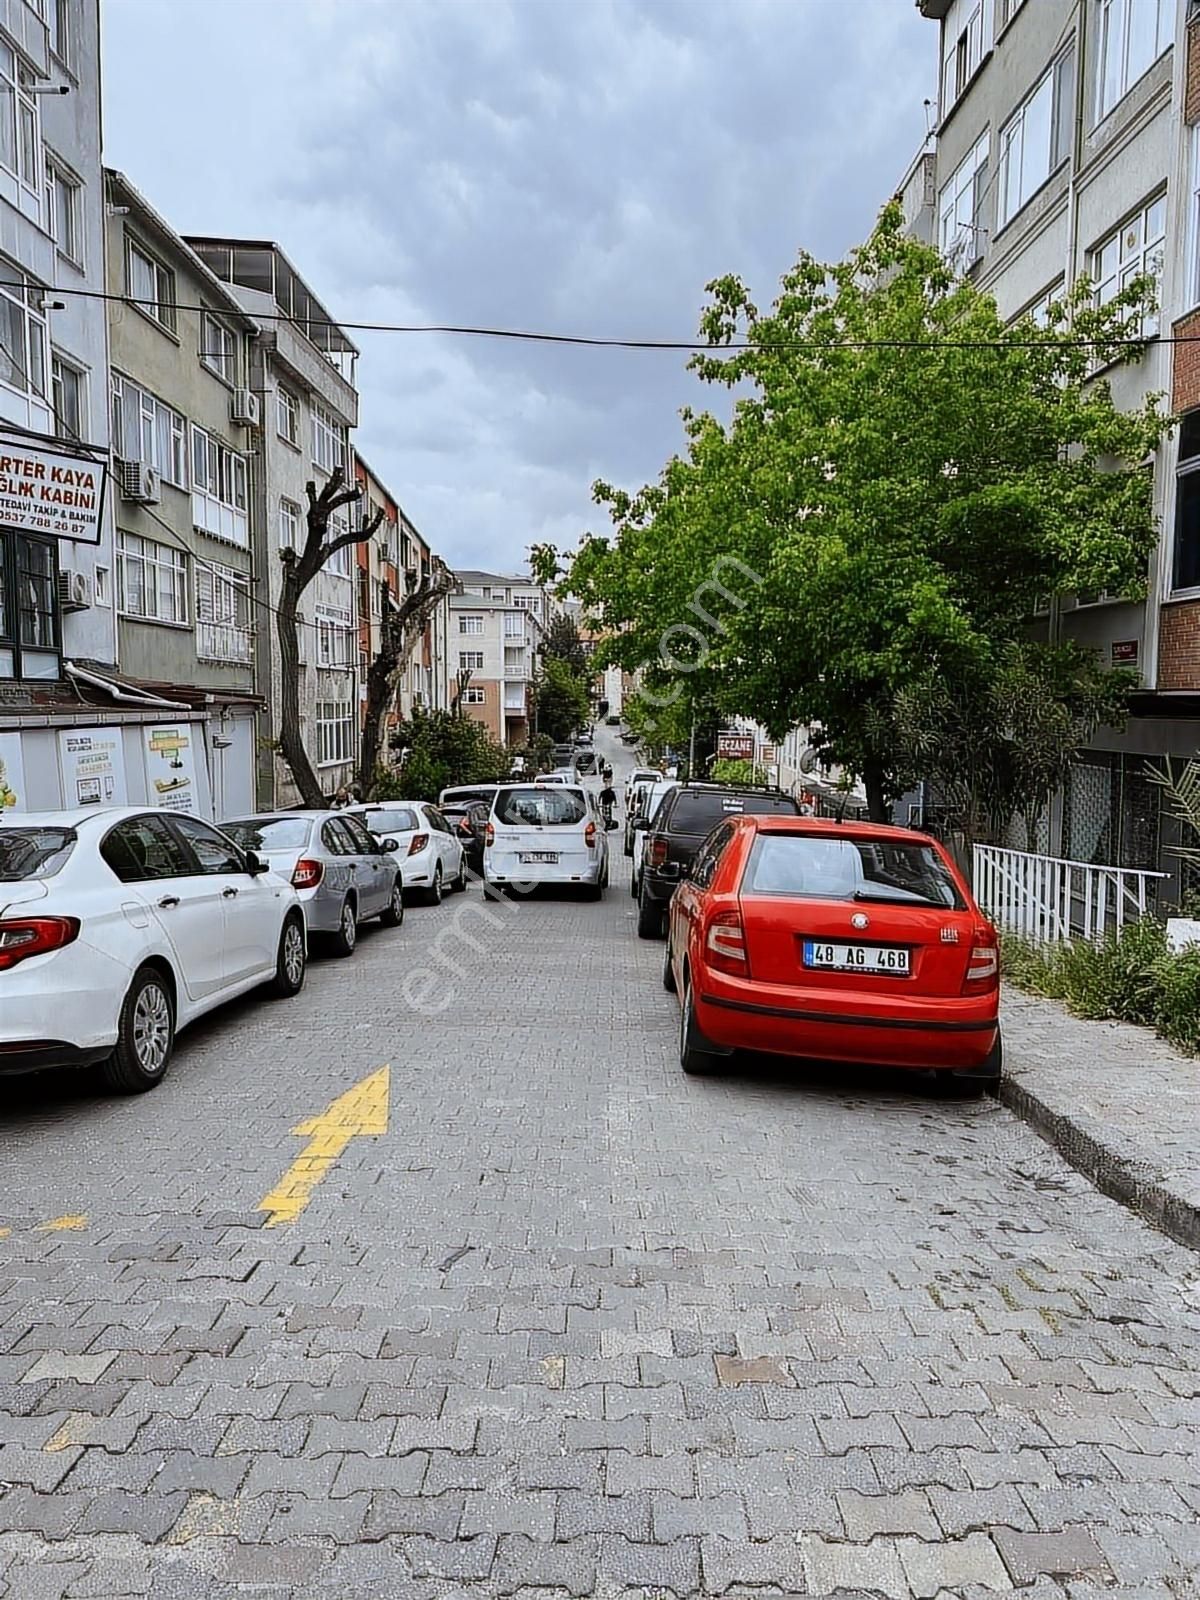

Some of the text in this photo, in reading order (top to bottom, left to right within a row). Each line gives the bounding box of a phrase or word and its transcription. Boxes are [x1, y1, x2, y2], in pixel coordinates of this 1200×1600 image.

[51, 466, 94, 490] KAYA
[40, 485, 96, 510] KABİNİ
[30, 515, 51, 528] 788
[54, 520, 68, 531] 26
[71, 523, 86, 534] 87
[720, 739, 752, 751] ECZANE
[815, 945, 834, 963] 48
[846, 948, 865, 965] AG
[877, 950, 906, 968] 468
